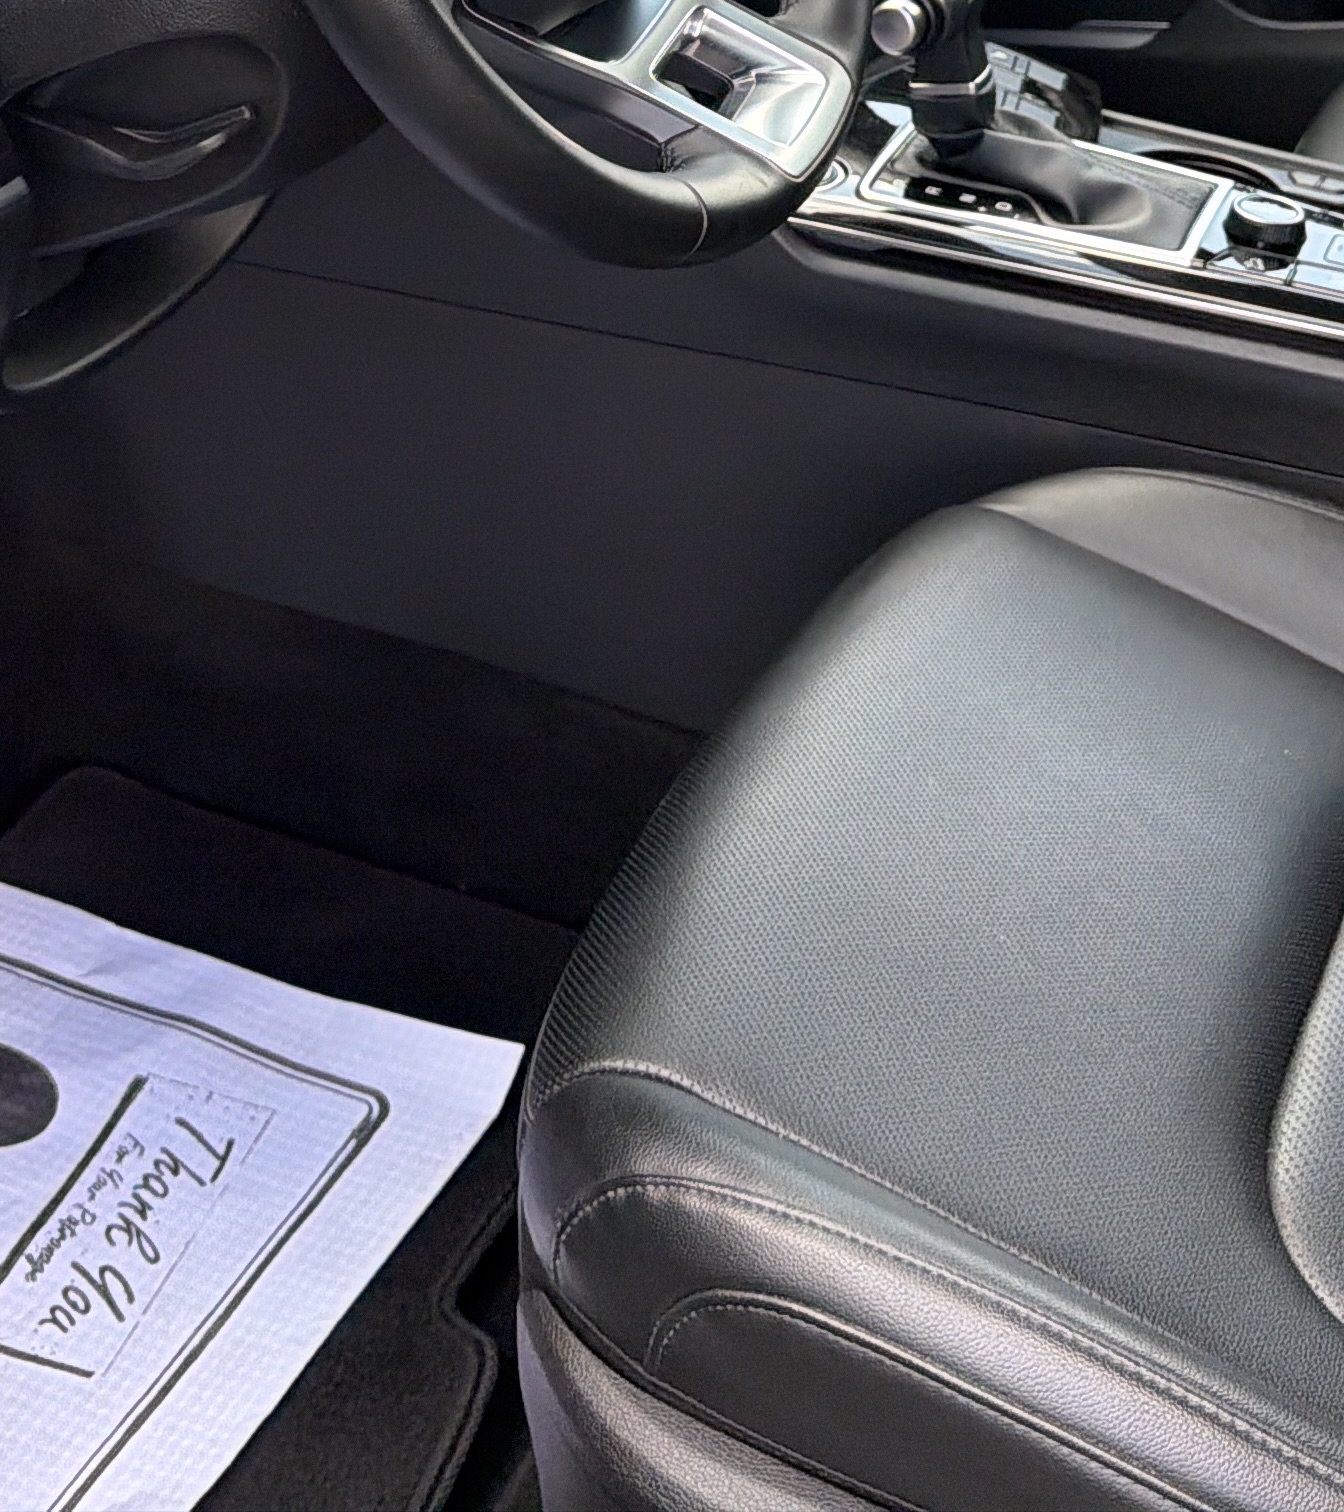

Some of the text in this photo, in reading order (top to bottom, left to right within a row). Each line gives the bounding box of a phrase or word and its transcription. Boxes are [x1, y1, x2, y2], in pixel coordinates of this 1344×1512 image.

[24, 1133, 147, 1285] For Your Patronage
[38, 1116, 236, 1335] Thank You
